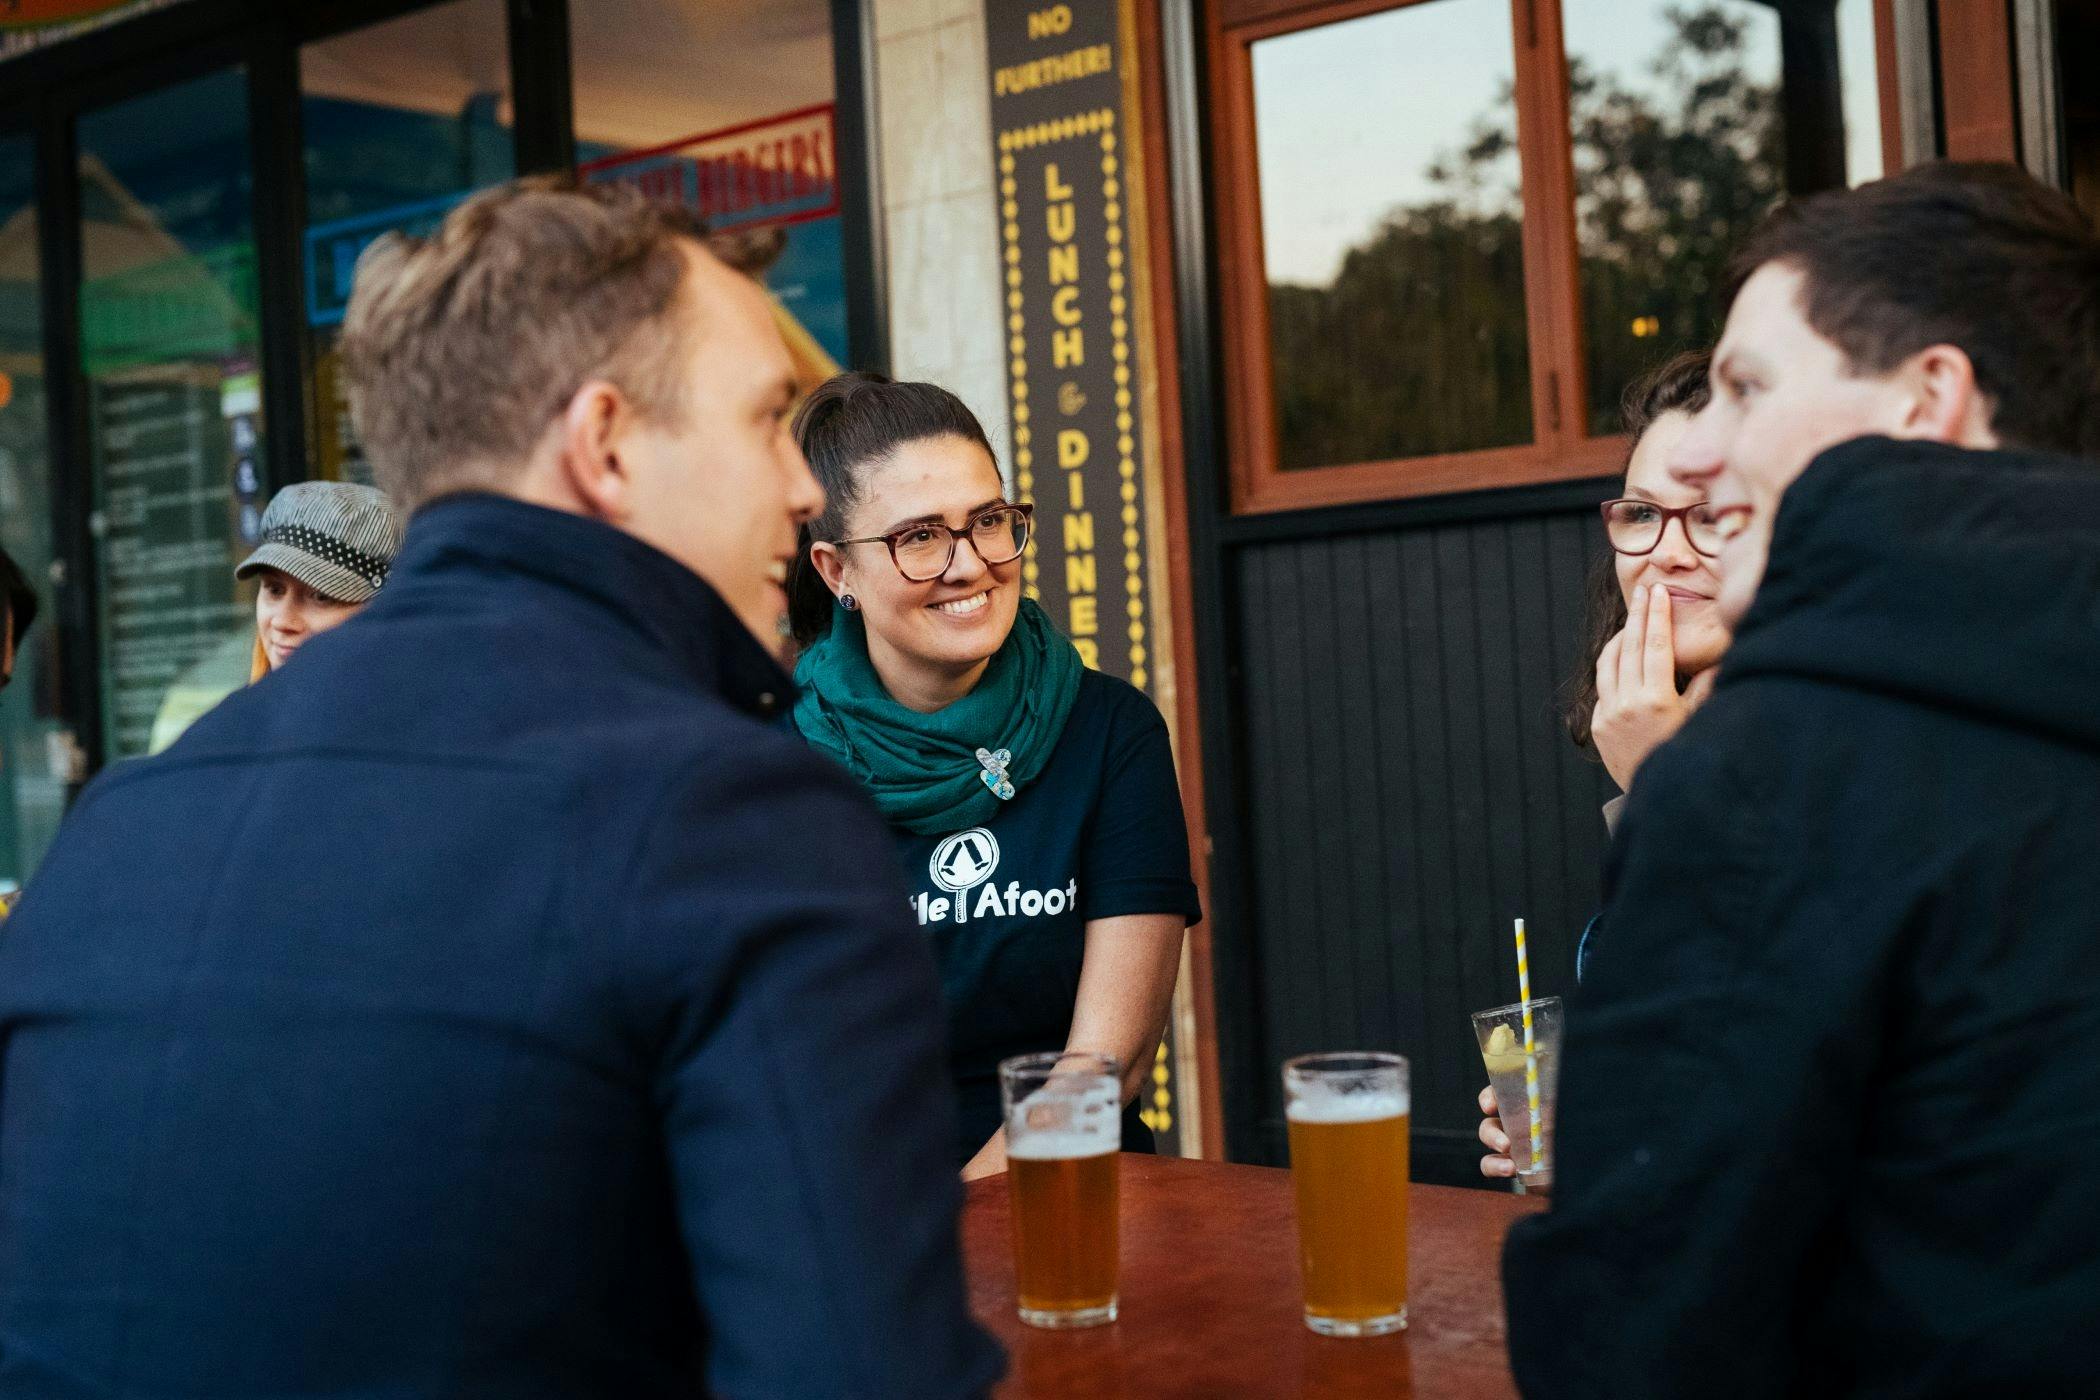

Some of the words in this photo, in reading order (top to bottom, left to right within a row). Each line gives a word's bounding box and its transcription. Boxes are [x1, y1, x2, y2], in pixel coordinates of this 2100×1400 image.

[1028, 5, 1072, 40] NO
[1045, 163, 1084, 368] LUNCH
[973, 877, 1077, 918] Afoot
